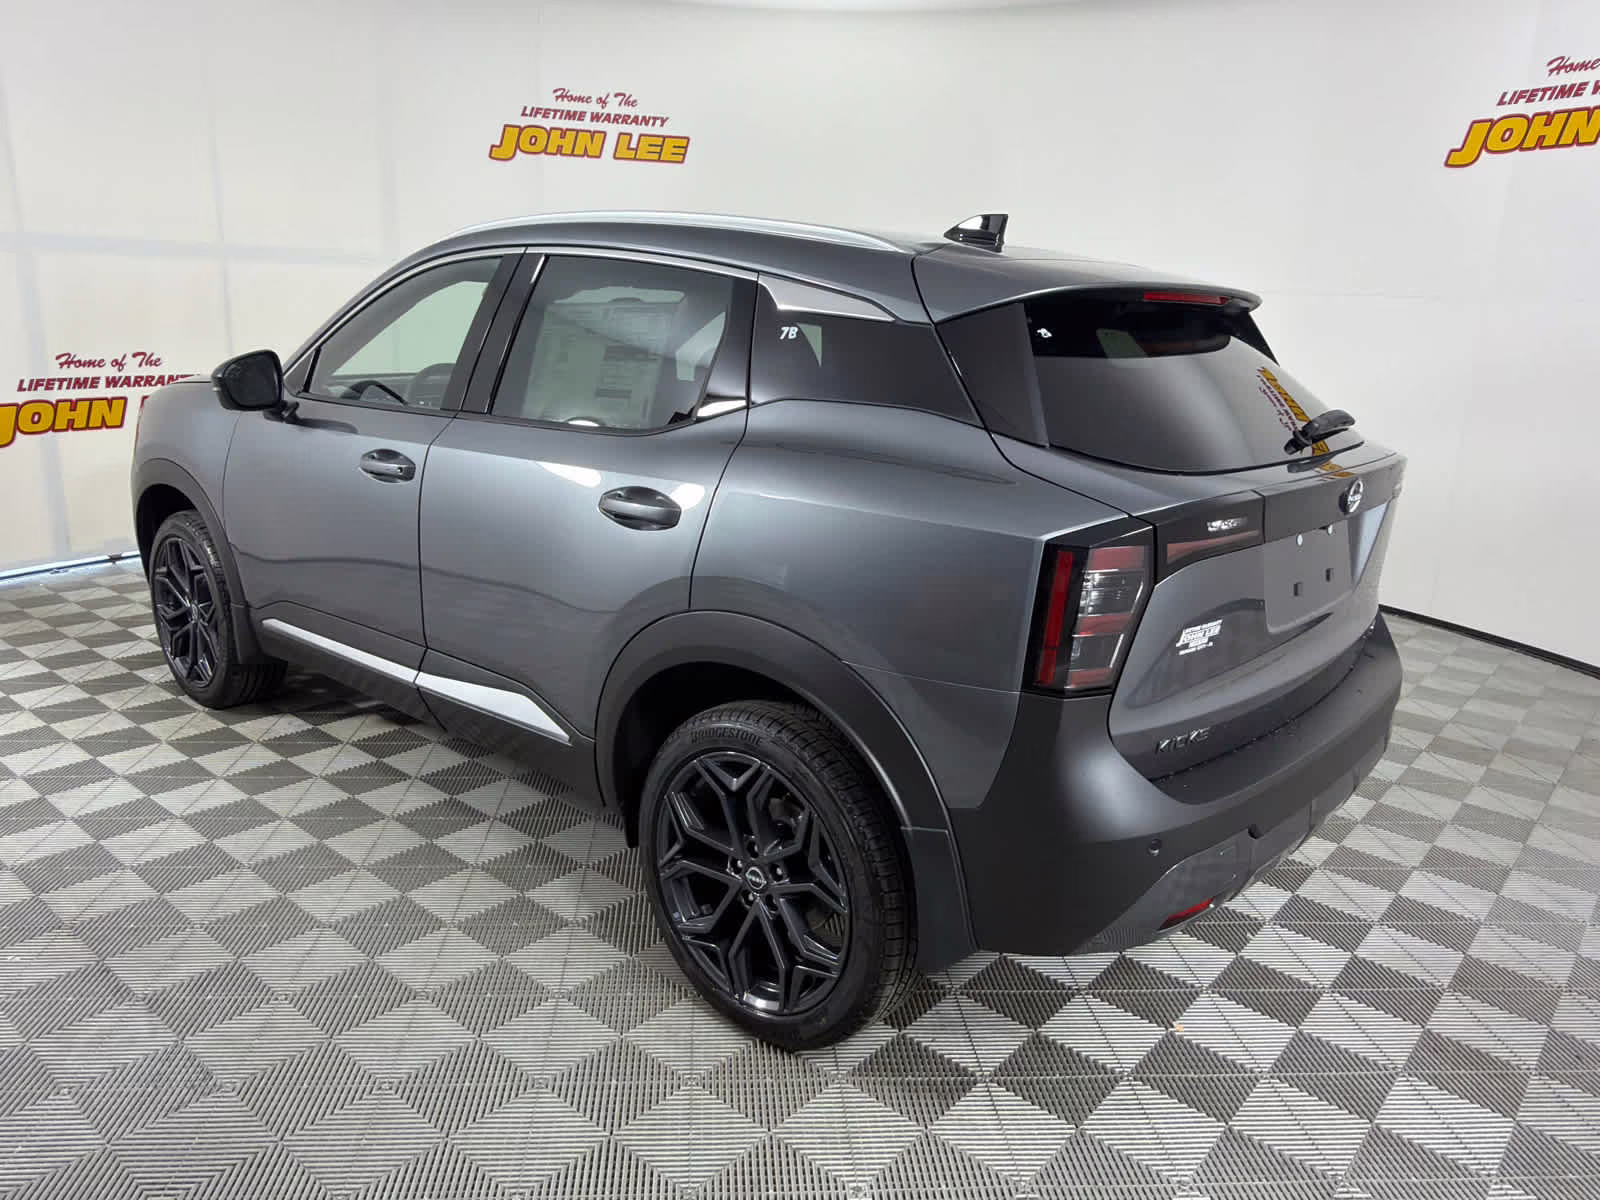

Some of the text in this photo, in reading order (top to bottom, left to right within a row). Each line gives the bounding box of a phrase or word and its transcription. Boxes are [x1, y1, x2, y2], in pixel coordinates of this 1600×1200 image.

[1546, 56, 1600, 76] Home
[552, 88, 638, 108] Home of The
[1496, 81, 1589, 106] LIFETIME
[521, 106, 669, 127] LIFETIME WARRANTY
[489, 124, 690, 163] JOHN LEE
[1444, 105, 1600, 168] JOHN
[55, 352, 162, 372] Home of The
[17, 374, 196, 392] LIFETIME WARRAN
